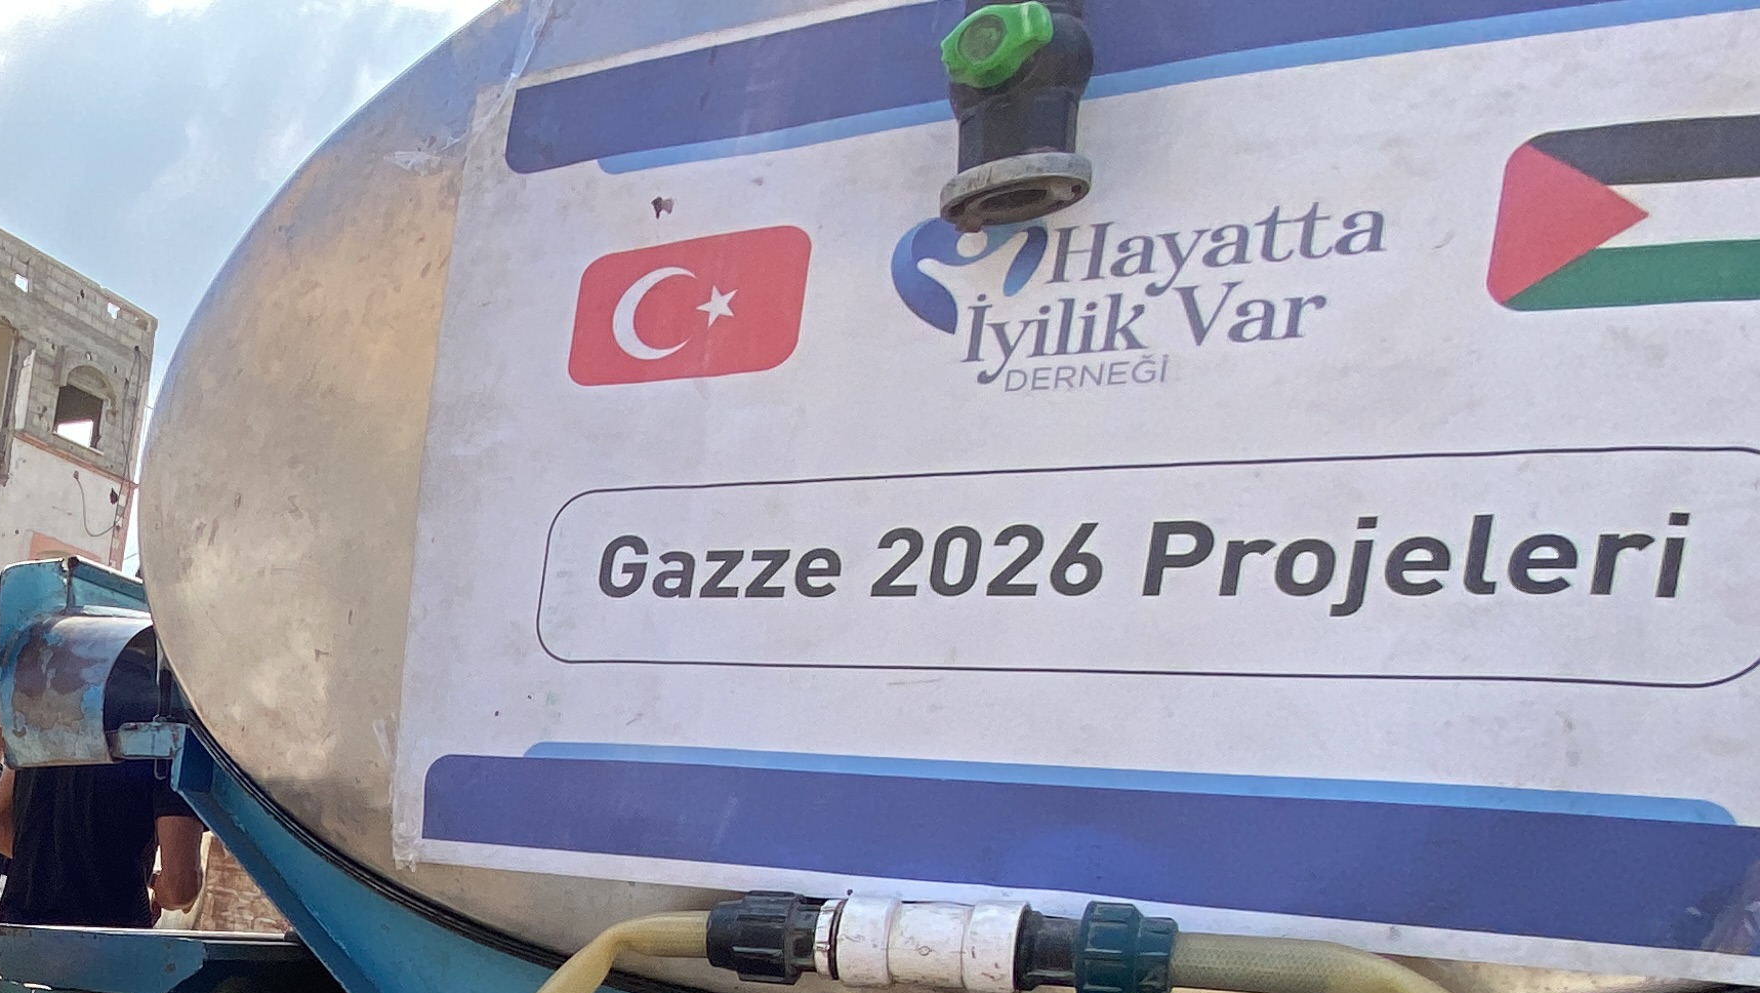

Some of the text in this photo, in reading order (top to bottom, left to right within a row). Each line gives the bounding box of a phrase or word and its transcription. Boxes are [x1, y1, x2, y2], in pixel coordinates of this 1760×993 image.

[1046, 202, 1387, 297] Hayatta
[960, 281, 1328, 385] İyilik Var
[1004, 354, 1170, 393] DERNEĞİ
[597, 510, 1692, 618] Gazze 2026 Projeleri
